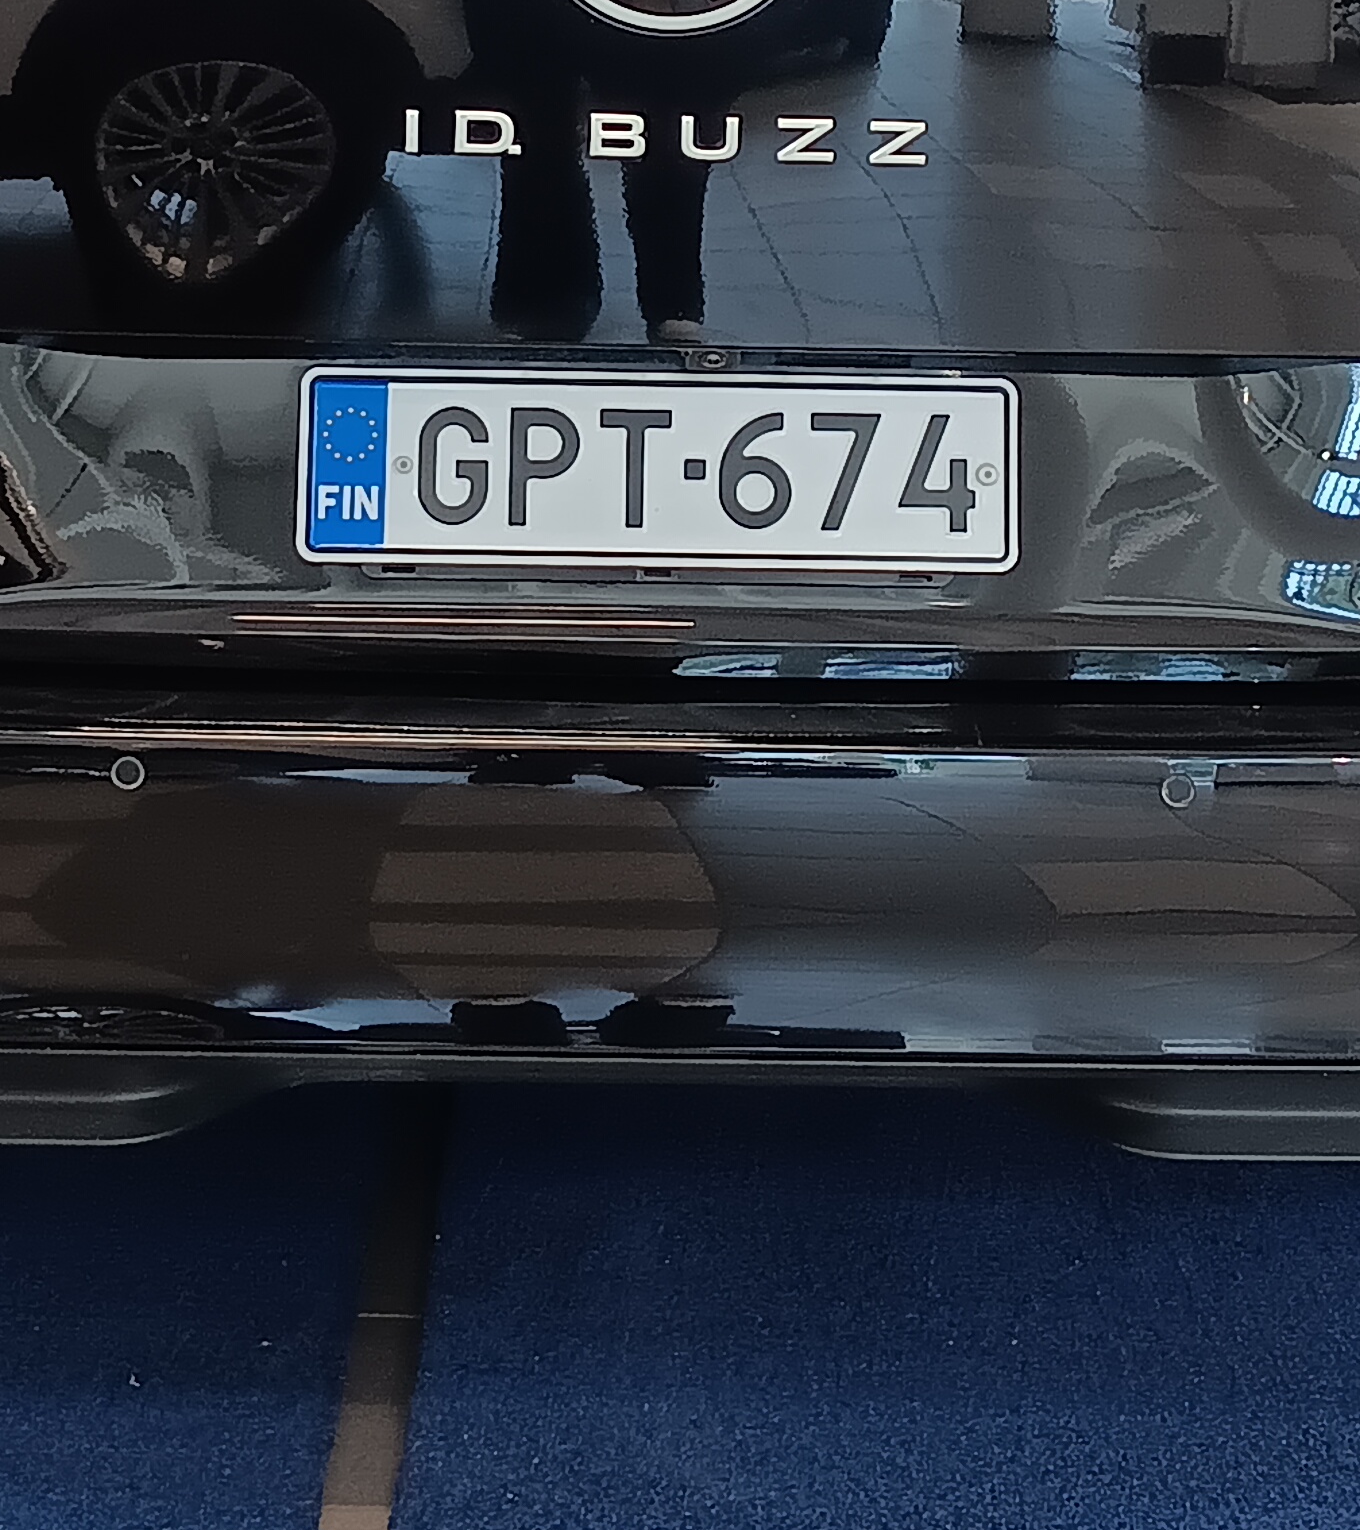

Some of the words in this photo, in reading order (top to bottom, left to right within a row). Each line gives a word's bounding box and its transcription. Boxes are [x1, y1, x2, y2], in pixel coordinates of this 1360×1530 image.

[588, 111, 927, 166] BUZZ
[417, 405, 977, 534] GPT-674
[316, 483, 380, 521] FIN
